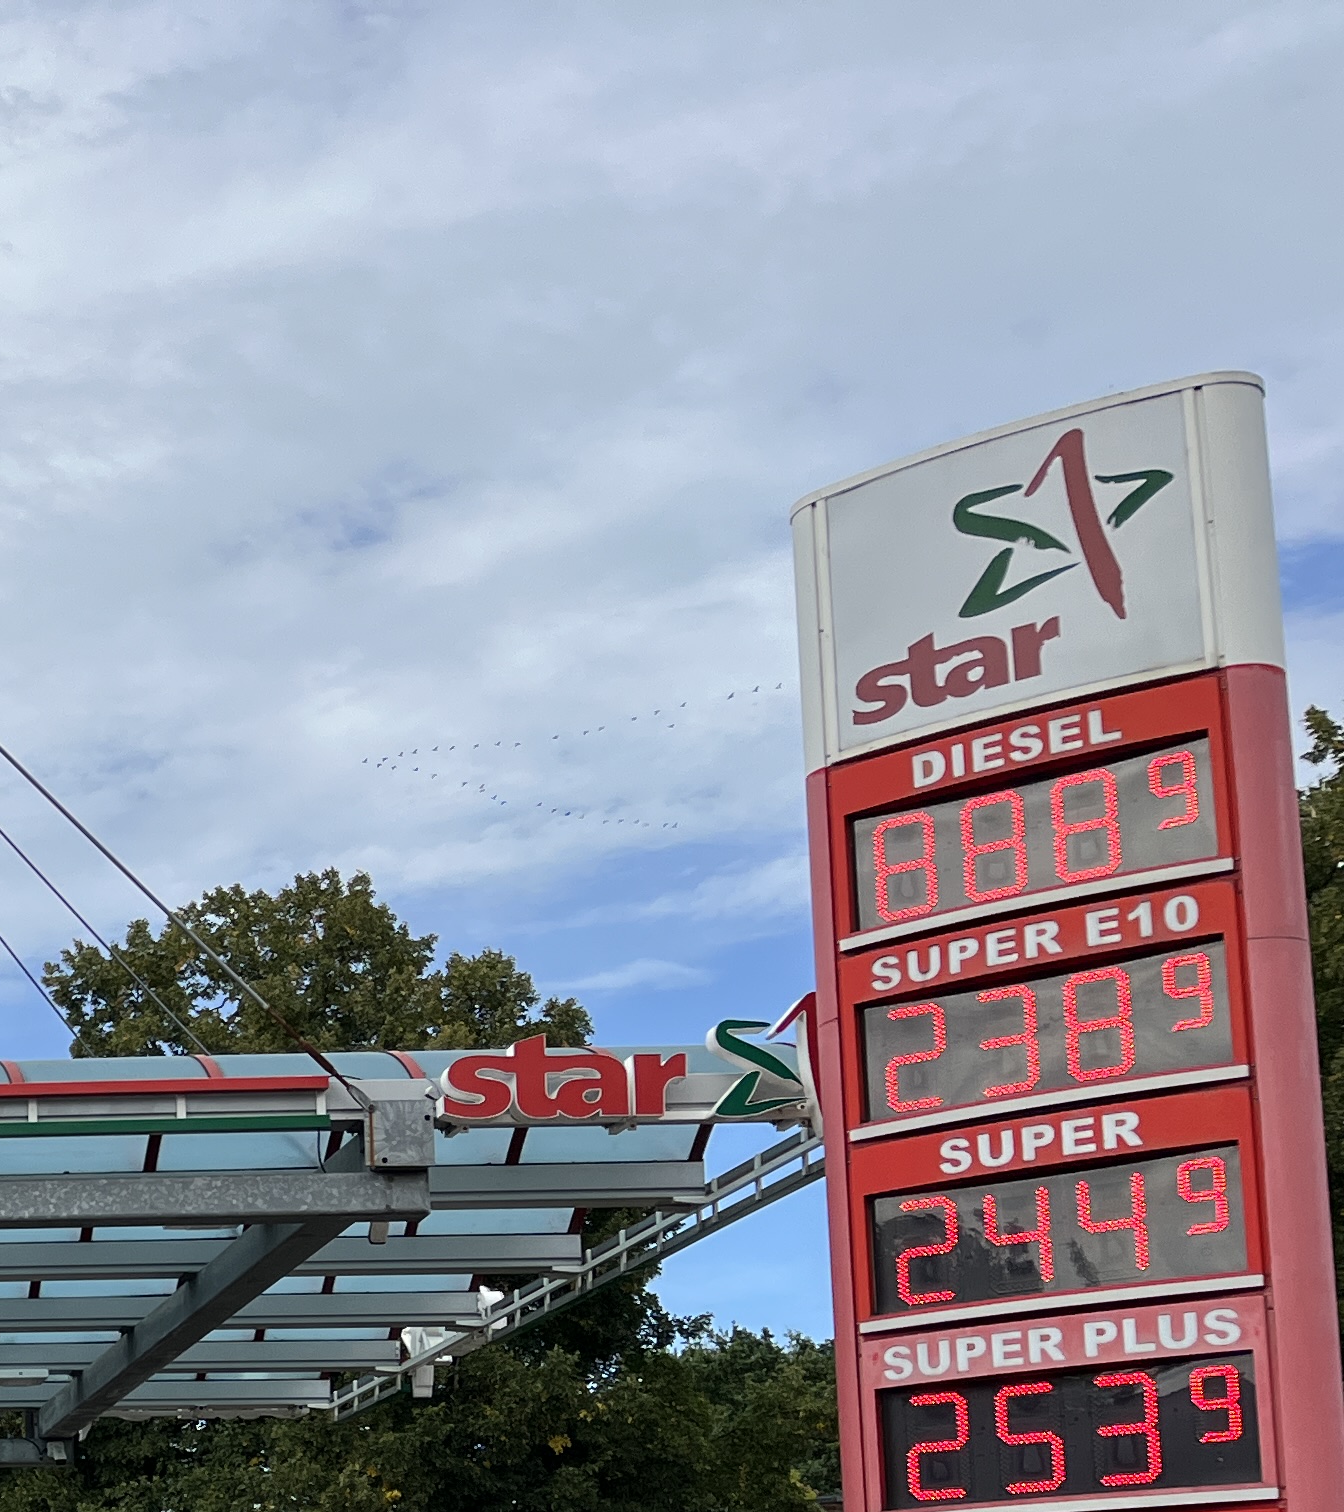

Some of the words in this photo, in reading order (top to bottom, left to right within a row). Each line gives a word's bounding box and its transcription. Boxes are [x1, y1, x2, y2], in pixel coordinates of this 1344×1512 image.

[852, 614, 1062, 726] star
[912, 709, 1122, 789] DIESEL
[870, 918, 1061, 993] SUPER
[1085, 894, 1200, 945] E10
[436, 1033, 688, 1122] star
[883, 951, 1214, 1113] 2389
[938, 1111, 1143, 1175] SUPER
[895, 1156, 1230, 1305] 2449
[882, 1325, 1065, 1382] SUPER
[1091, 1308, 1243, 1356] PLUS
[906, 1363, 1244, 1501] 2539
